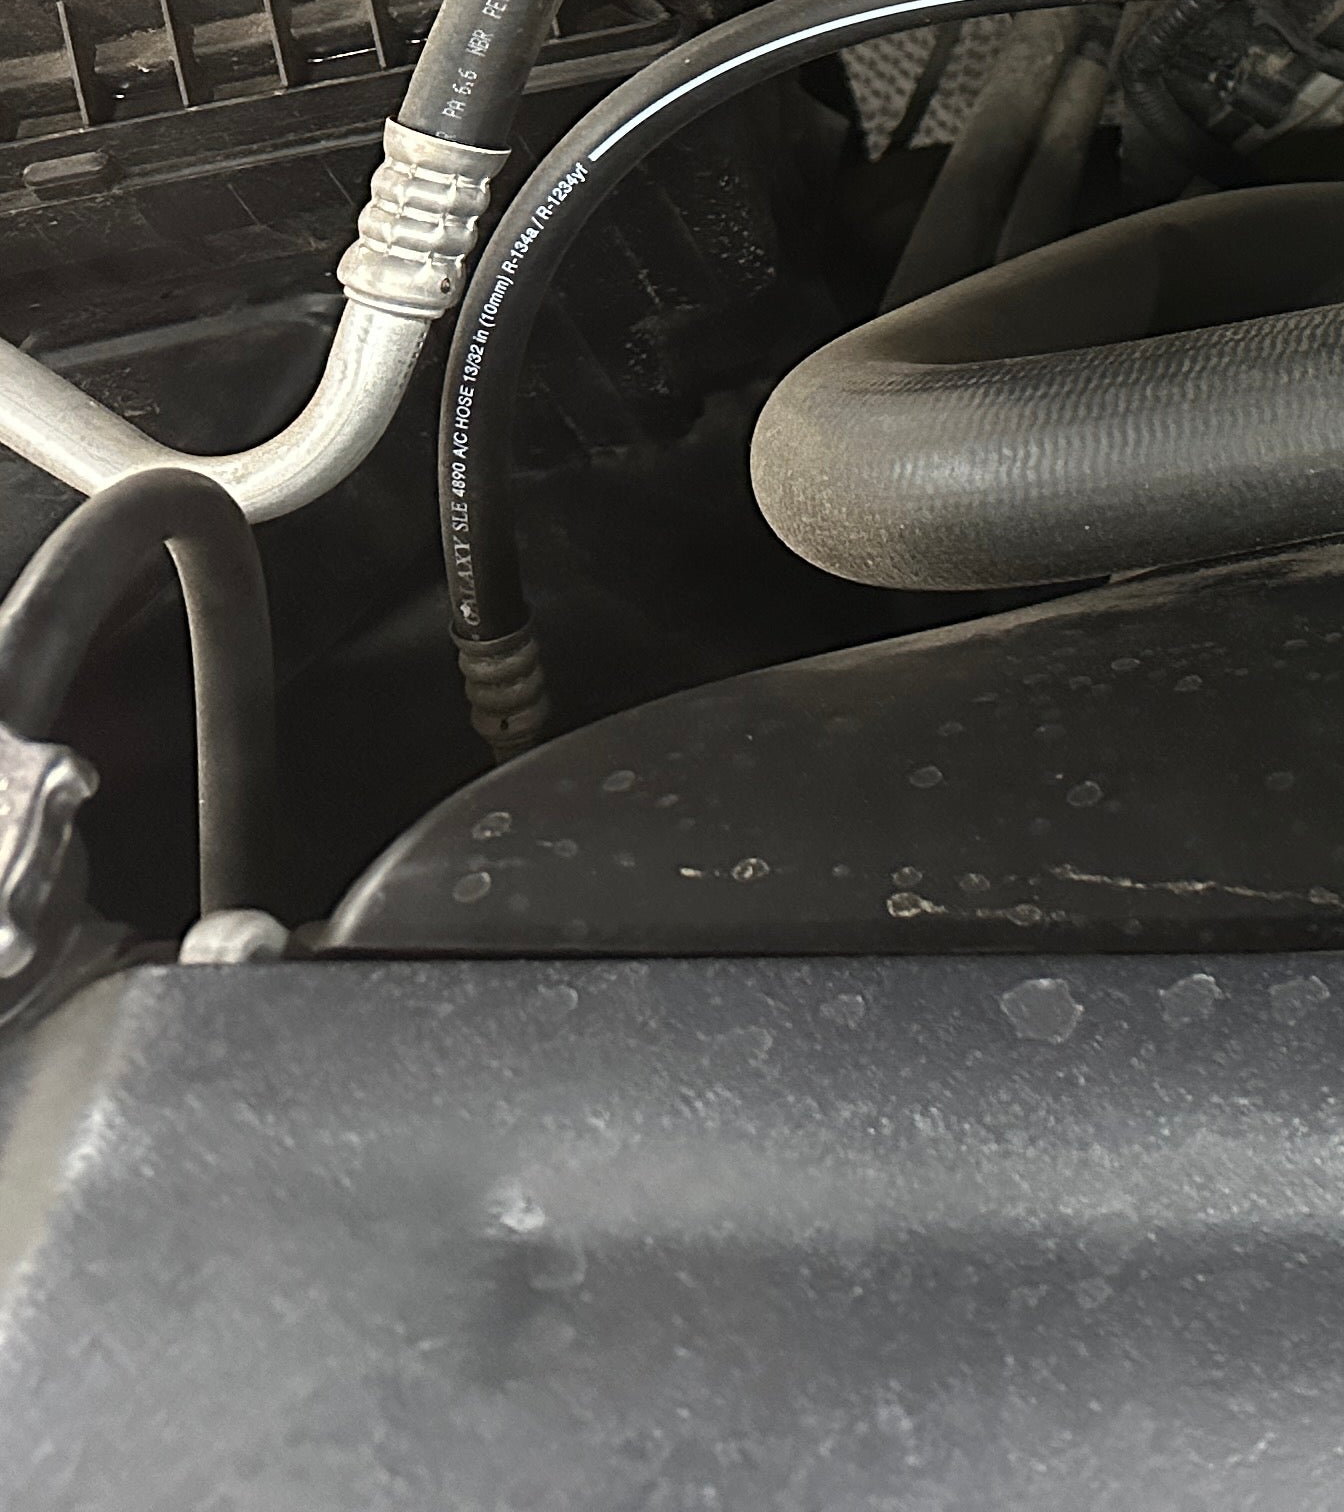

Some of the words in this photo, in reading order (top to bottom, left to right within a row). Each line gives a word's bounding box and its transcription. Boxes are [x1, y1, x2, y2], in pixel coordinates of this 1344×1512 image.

[535, 161, 590, 221] R-1234yf
[501, 225, 541, 275] R-134a
[478, 274, 515, 329] (10mm)
[472, 327, 490, 348] in
[462, 342, 485, 383] 13/32
[454, 384, 476, 430] HOSE
[452, 428, 469, 459] A/C
[451, 461, 467, 498] 4890
[450, 500, 470, 533] SLE
[453, 535, 481, 626] GALAXY
